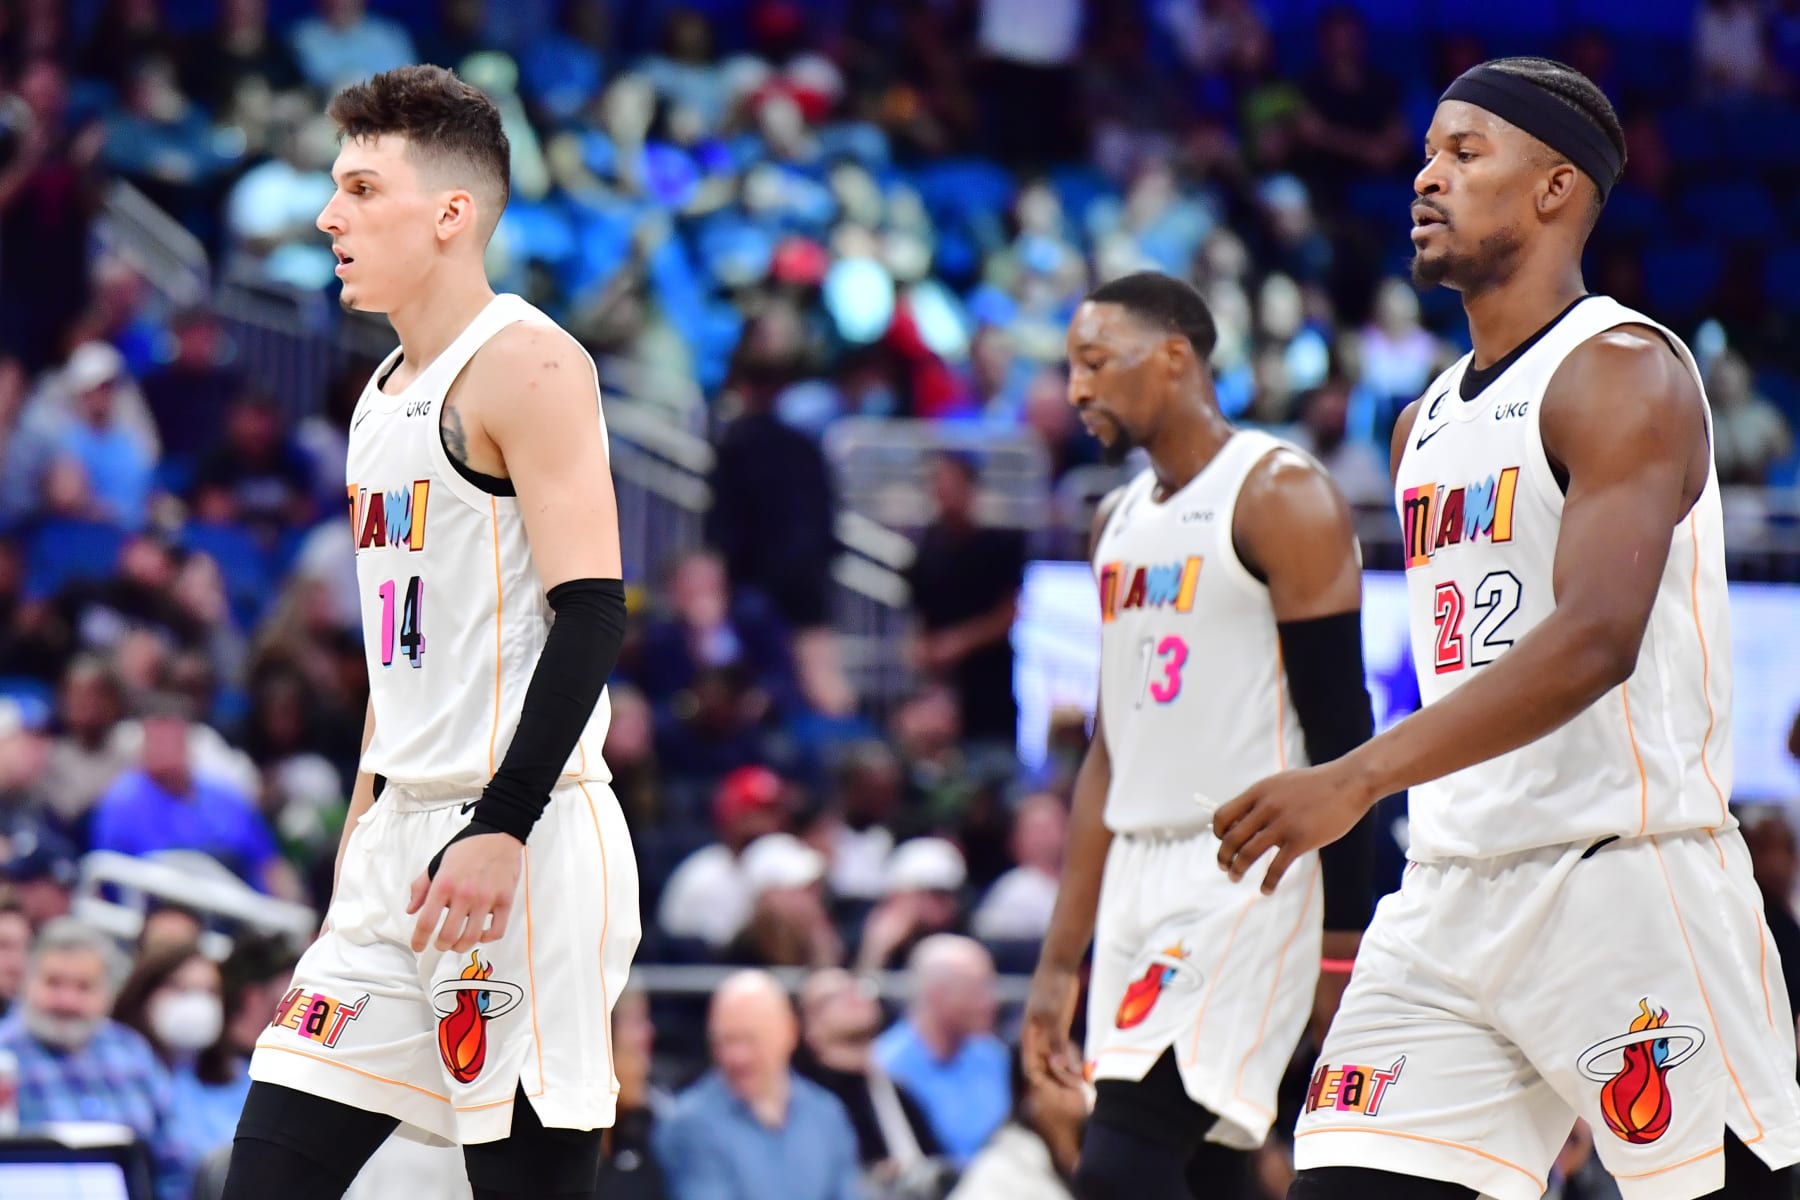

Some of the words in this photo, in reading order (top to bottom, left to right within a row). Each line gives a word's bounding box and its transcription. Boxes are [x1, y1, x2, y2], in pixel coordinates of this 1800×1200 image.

[406, 401, 432, 417] UKG
[1495, 401, 1529, 420] UKG
[378, 575, 426, 669] 14
[1434, 570, 1522, 675] 22
